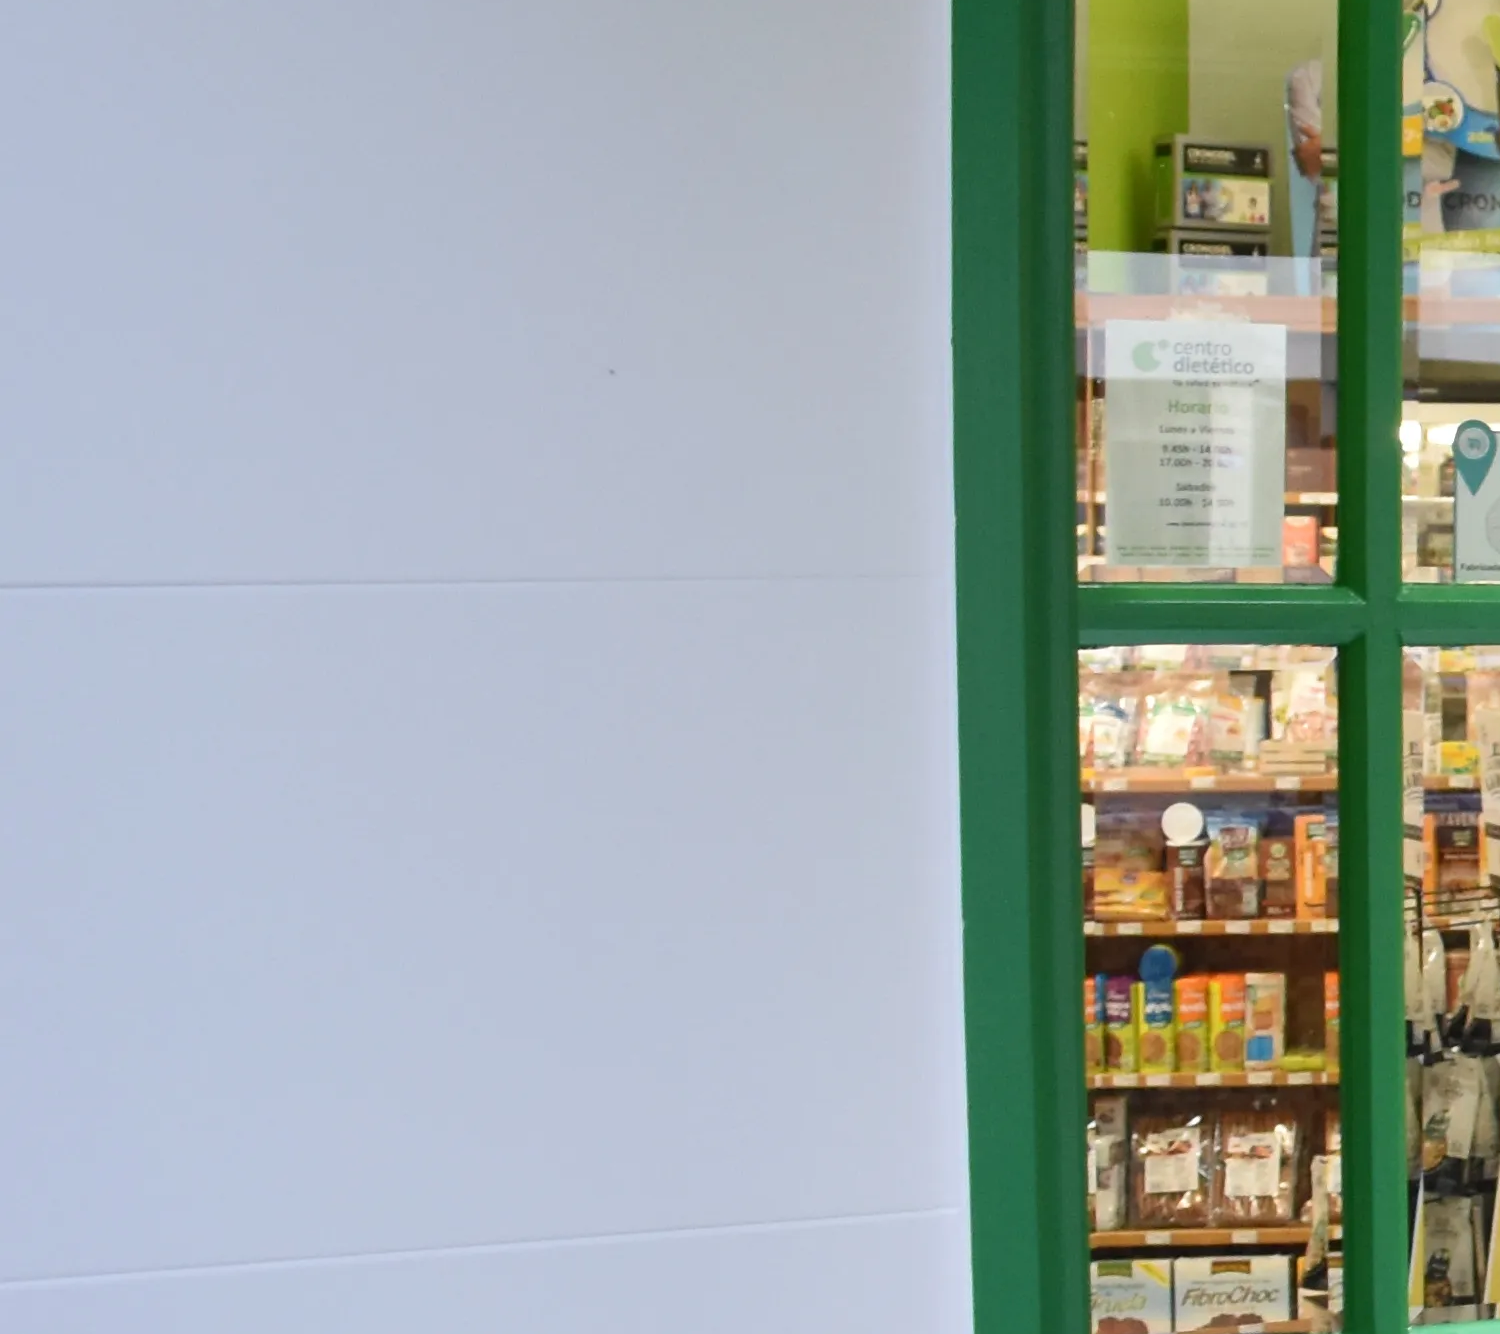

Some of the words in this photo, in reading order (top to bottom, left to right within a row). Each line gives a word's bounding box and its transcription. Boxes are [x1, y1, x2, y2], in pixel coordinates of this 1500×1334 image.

[1172, 340, 1233, 357] centro
[1172, 356, 1256, 375] dietético
[1180, 1284, 1282, 1308] FibroChoc
